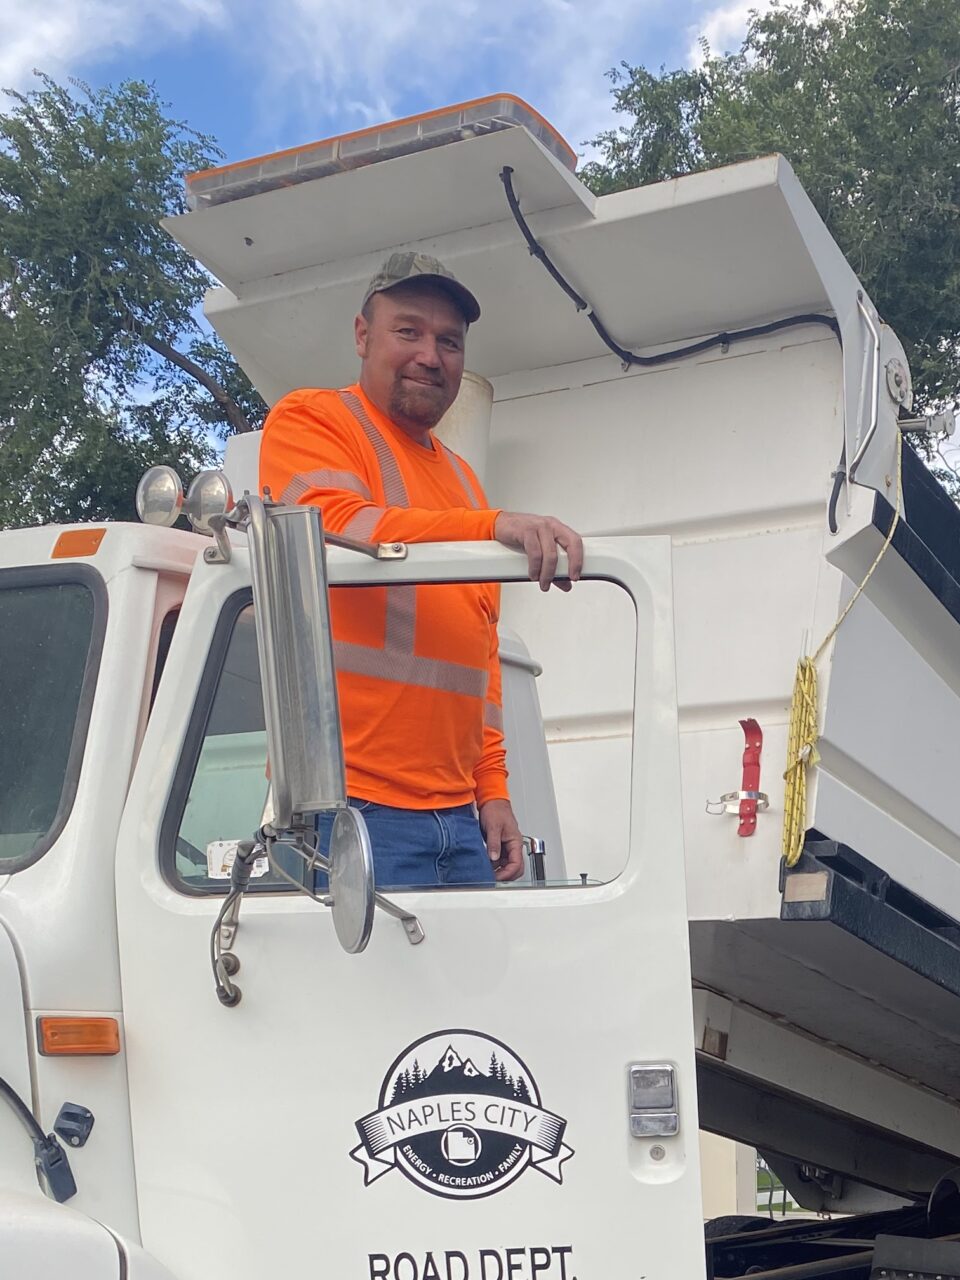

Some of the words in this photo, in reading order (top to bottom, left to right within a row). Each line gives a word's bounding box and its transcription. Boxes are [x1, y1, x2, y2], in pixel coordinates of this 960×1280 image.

[386, 1101, 476, 1135] NAPLES
[484, 1103, 537, 1132] CITY
[402, 1144, 432, 1175] ENERGY
[438, 1171, 493, 1186] RECREATION
[499, 1143, 523, 1172] FAMILY
